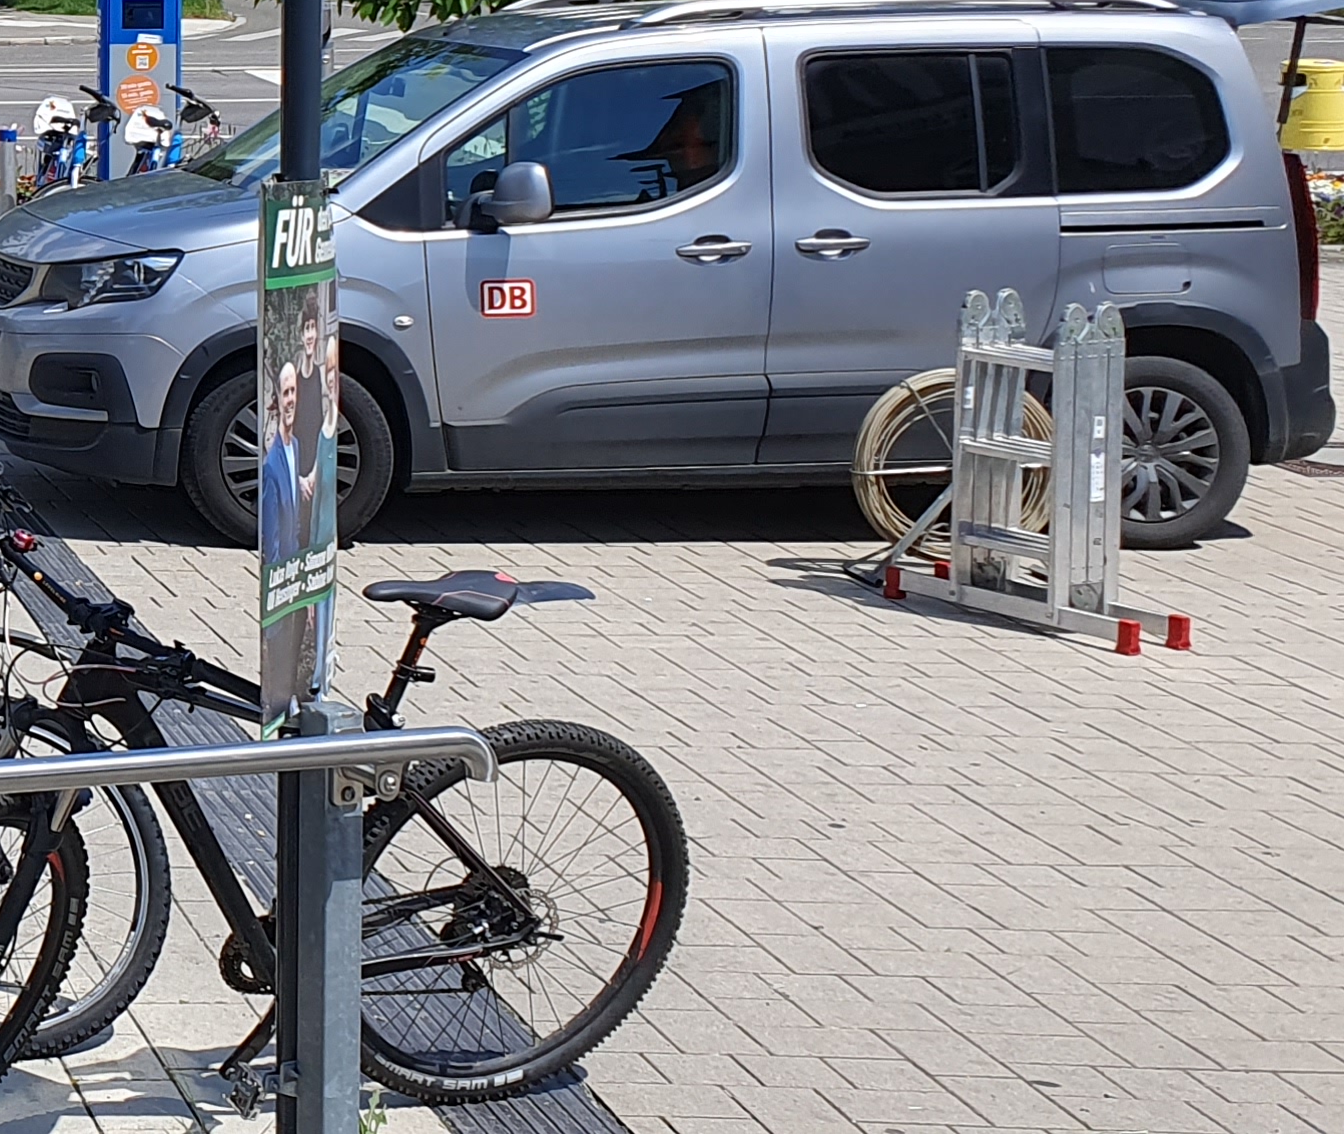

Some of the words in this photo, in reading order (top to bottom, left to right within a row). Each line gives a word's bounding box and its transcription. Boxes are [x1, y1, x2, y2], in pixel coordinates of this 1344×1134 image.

[272, 194, 315, 269] FÜR
[488, 286, 528, 310] DB
[374, 1052, 437, 1088] SMART
[442, 1078, 489, 1091] SAM
